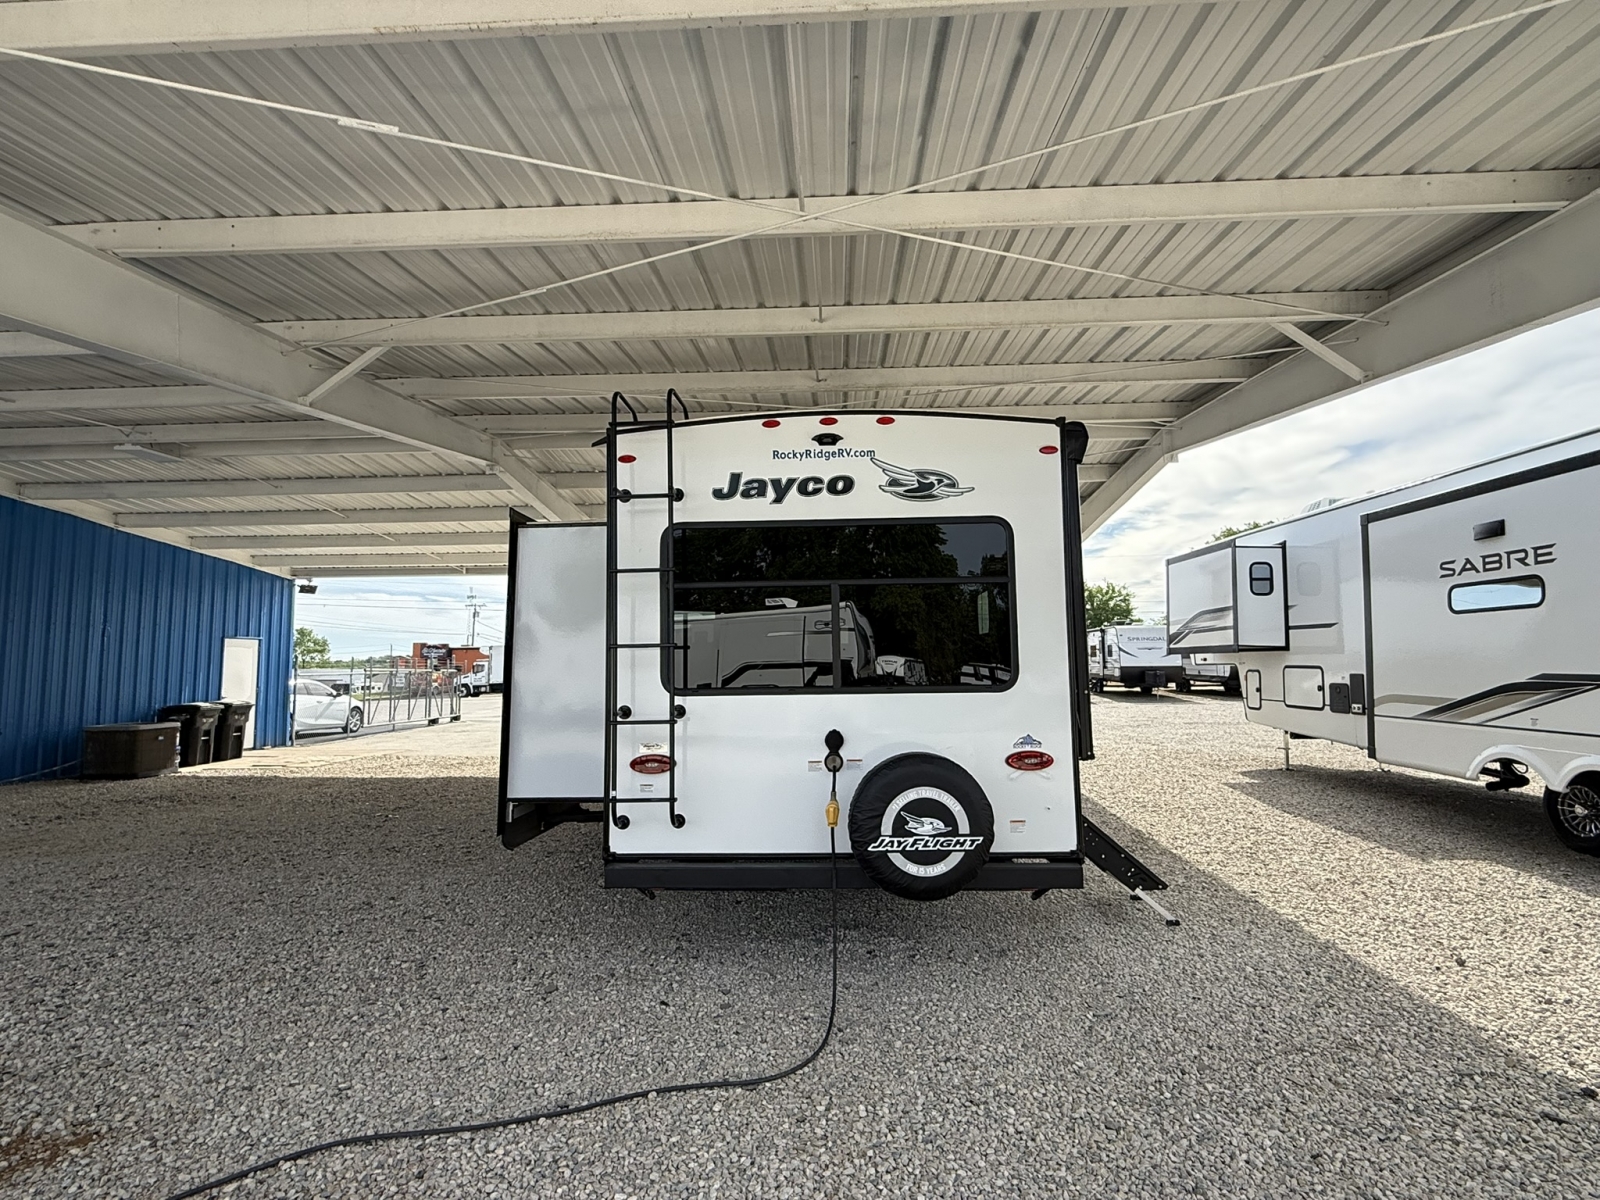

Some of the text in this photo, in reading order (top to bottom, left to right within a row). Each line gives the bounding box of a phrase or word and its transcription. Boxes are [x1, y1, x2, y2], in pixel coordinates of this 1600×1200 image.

[772, 448, 876, 461] RockyRidgeRV.com
[712, 472, 856, 505] Jayco
[1439, 543, 1558, 579] SABRE
[898, 791, 918, 806] SELLING
[918, 789, 940, 799] TRAVEL
[940, 793, 961, 812] TRAILER
[905, 863, 946, 875] FOR 15 YEARS
